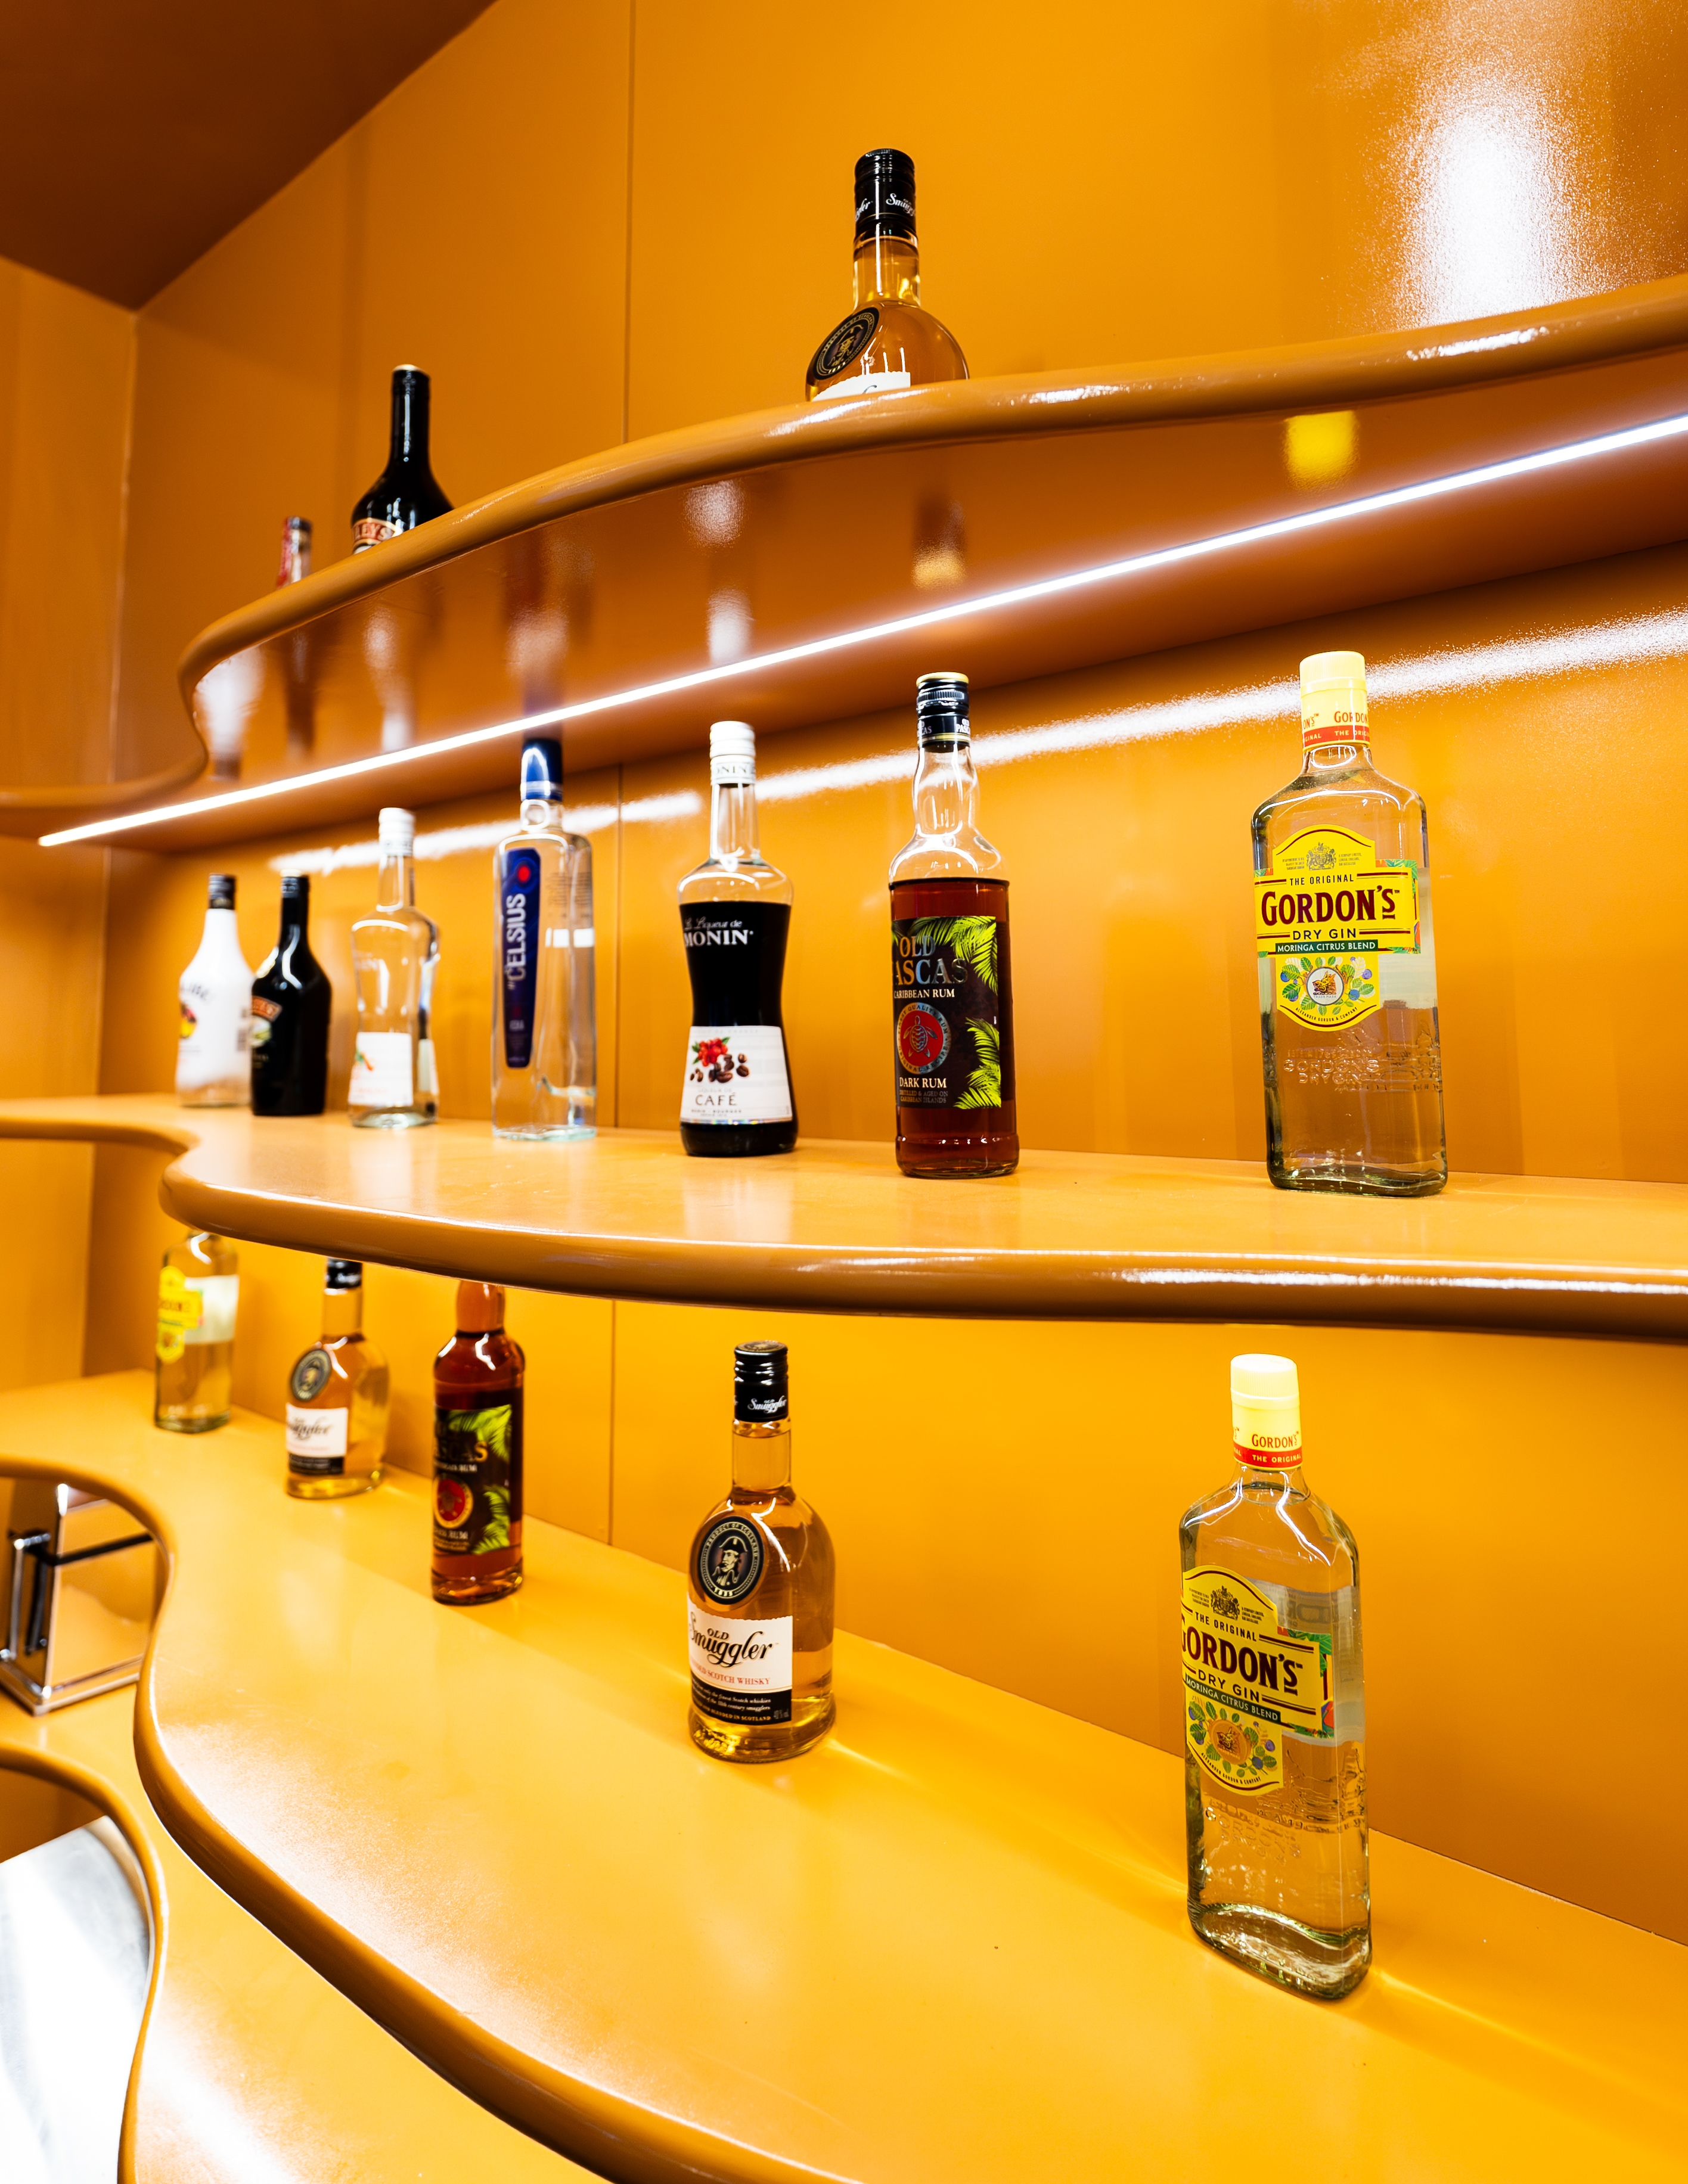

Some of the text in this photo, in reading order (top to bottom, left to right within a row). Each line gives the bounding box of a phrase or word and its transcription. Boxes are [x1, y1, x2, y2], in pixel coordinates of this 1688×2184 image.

[1290, 874, 1354, 886] THE ORIGINAL
[1261, 886, 1396, 926] GORDON'S
[730, 919, 742, 928] de
[684, 930, 749, 947] MONIN
[1293, 928, 1356, 940] DRY GIN
[899, 936, 936, 958] OLD
[1277, 942, 1376, 952] MORINGA CITRUS BLEND
[932, 988, 955, 998] RUM
[1295, 1007, 1316, 1020] ALEXANDER
[1340, 1006, 1358, 1019] COMPANY
[899, 1077, 947, 1089] DARK RUM
[695, 1092, 737, 1106] CAFÉ
[1252, 1433, 1297, 1448] GORDON'S
[1252, 1454, 1267, 1462] THE
[1271, 1453, 1301, 1463] ORIGINAL
[1195, 1611, 1209, 1625] THE
[1214, 1619, 1257, 1642] ORIGINAL
[690, 1611, 772, 1667] Smuggler
[707, 1628, 729, 1640] OLD
[708, 1670, 770, 1685] SCOTCH WHISKY
[1198, 1669, 1260, 1703] DRY GIN
[1186, 1677, 1278, 1721] MORINGA CITRUS BLEND
